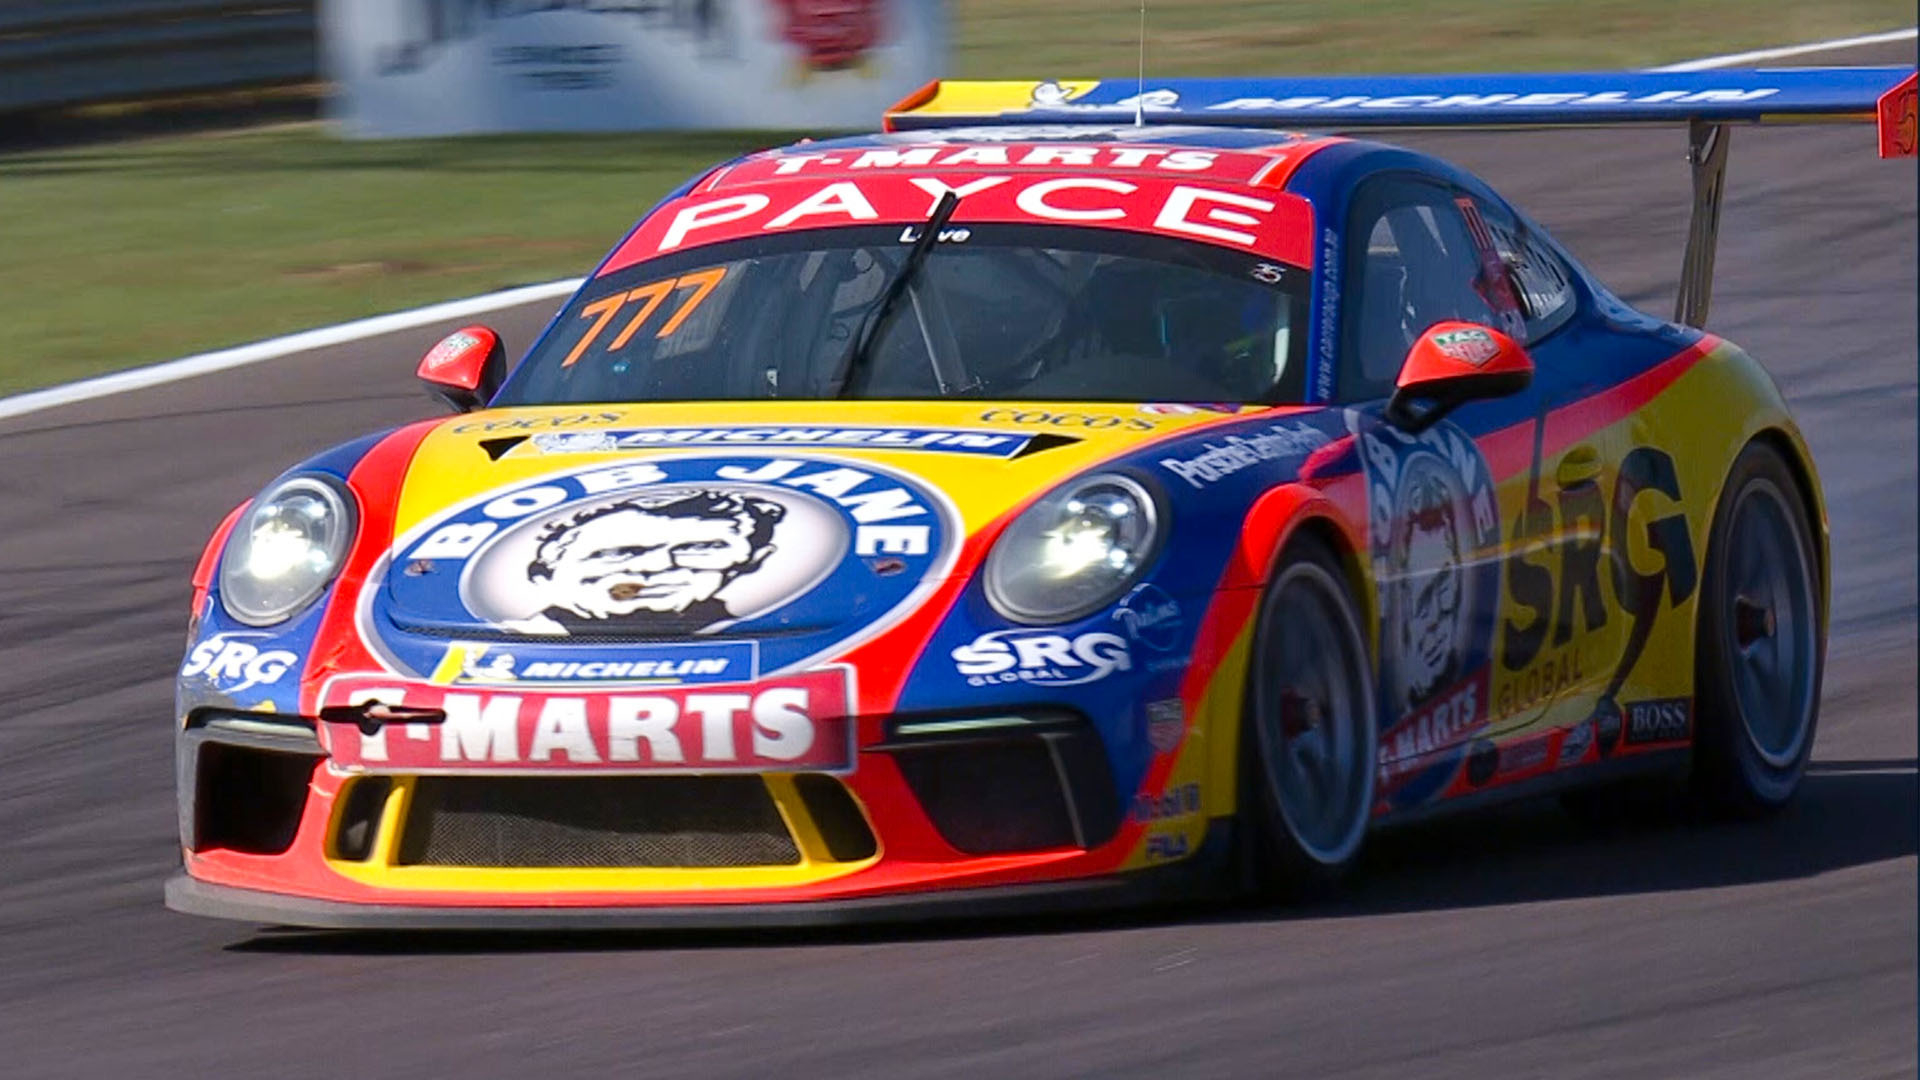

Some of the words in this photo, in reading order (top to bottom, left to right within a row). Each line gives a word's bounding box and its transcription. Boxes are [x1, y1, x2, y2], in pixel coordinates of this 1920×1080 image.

[1205, 88, 1780, 111] MICHELIN
[773, 144, 1219, 174] T-MARTS
[658, 175, 1277, 252] PAYCE
[899, 226, 971, 243] Lve
[561, 267, 728, 368] 777
[617, 430, 1012, 449] MICHELIN
[407, 462, 669, 560] BOB
[718, 458, 930, 556] JANE
[182, 638, 299, 684] SRG
[522, 657, 728, 679] MICHELIN
[951, 632, 1132, 676] SRG
[967, 670, 1068, 686] GLOBAL
[349, 685, 816, 763] T-MARTS
[1631, 702, 1687, 731] BOSS
